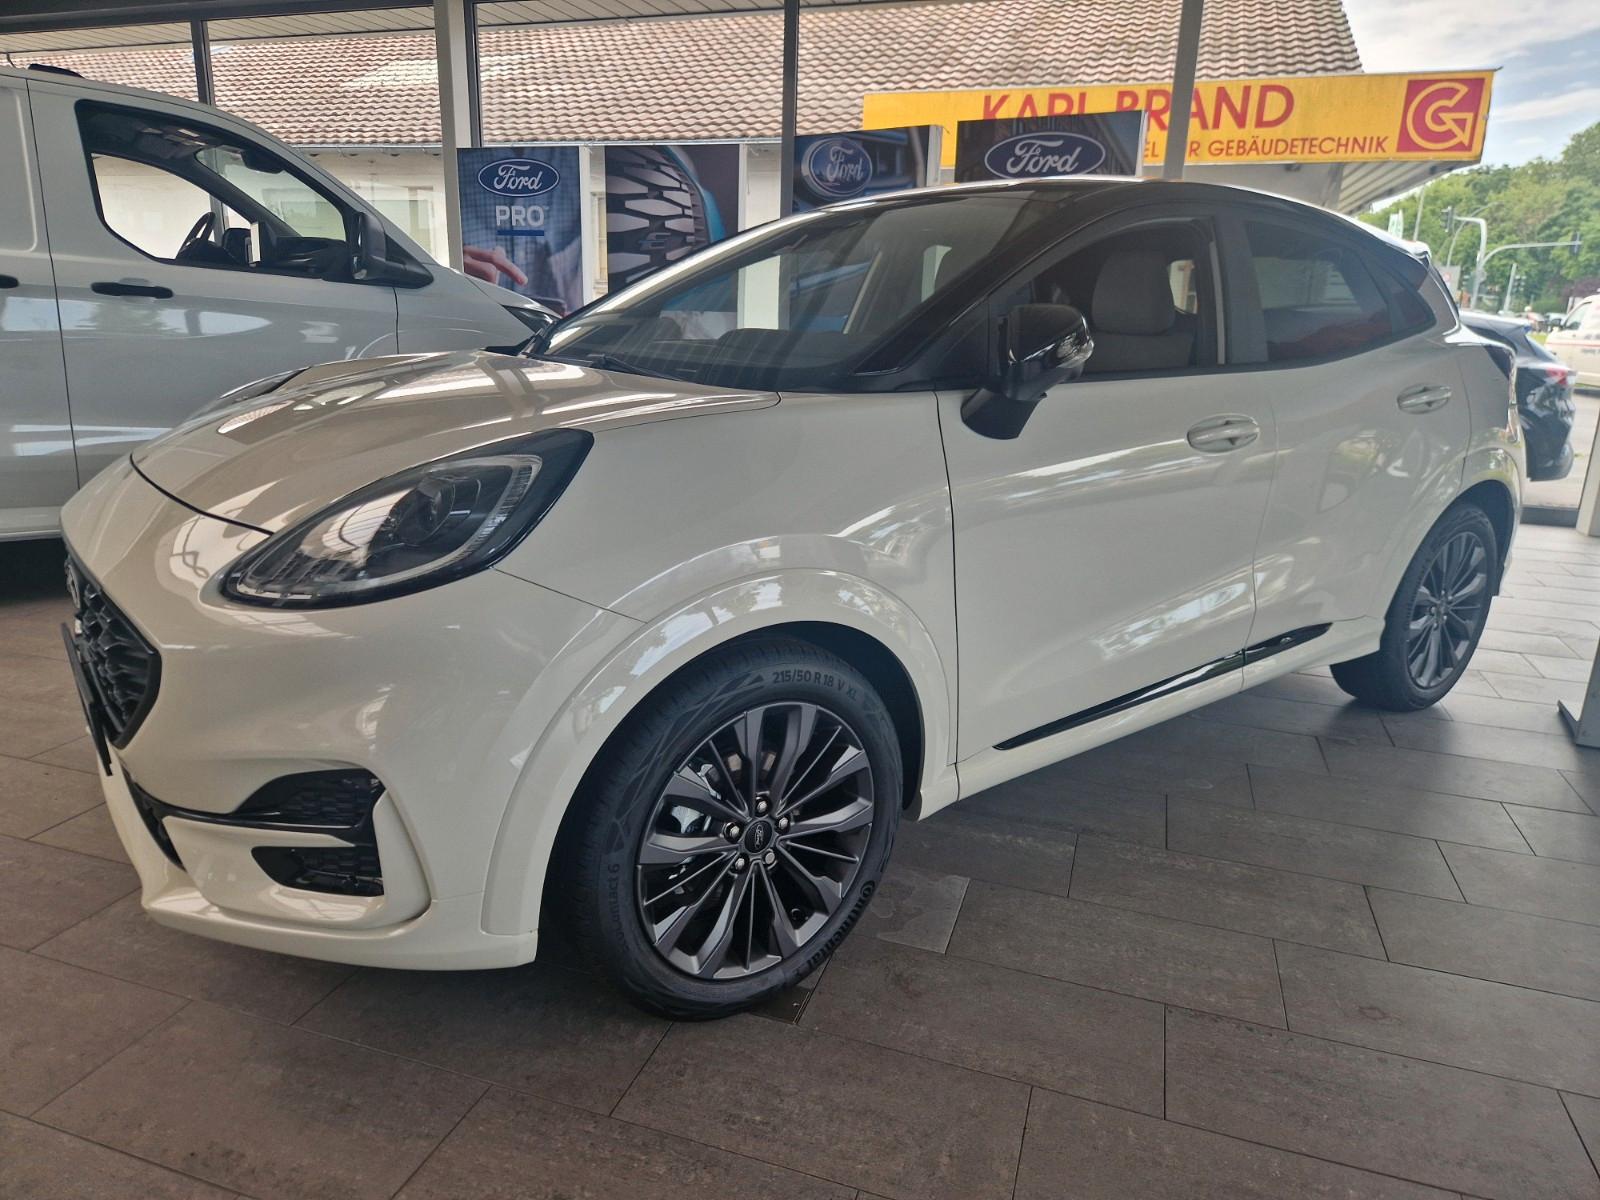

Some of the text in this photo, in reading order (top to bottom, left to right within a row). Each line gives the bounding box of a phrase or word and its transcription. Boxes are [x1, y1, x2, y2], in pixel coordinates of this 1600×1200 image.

[1006, 138, 1082, 174] Ford
[1208, 136, 1389, 157] GEBÄUDETECHNIK
[826, 145, 864, 182] Ford
[493, 164, 543, 190] Ford
[495, 205, 545, 227] PRO
[772, 669, 812, 684] 215/50
[814, 672, 822, 684] R
[823, 674, 834, 687] 18
